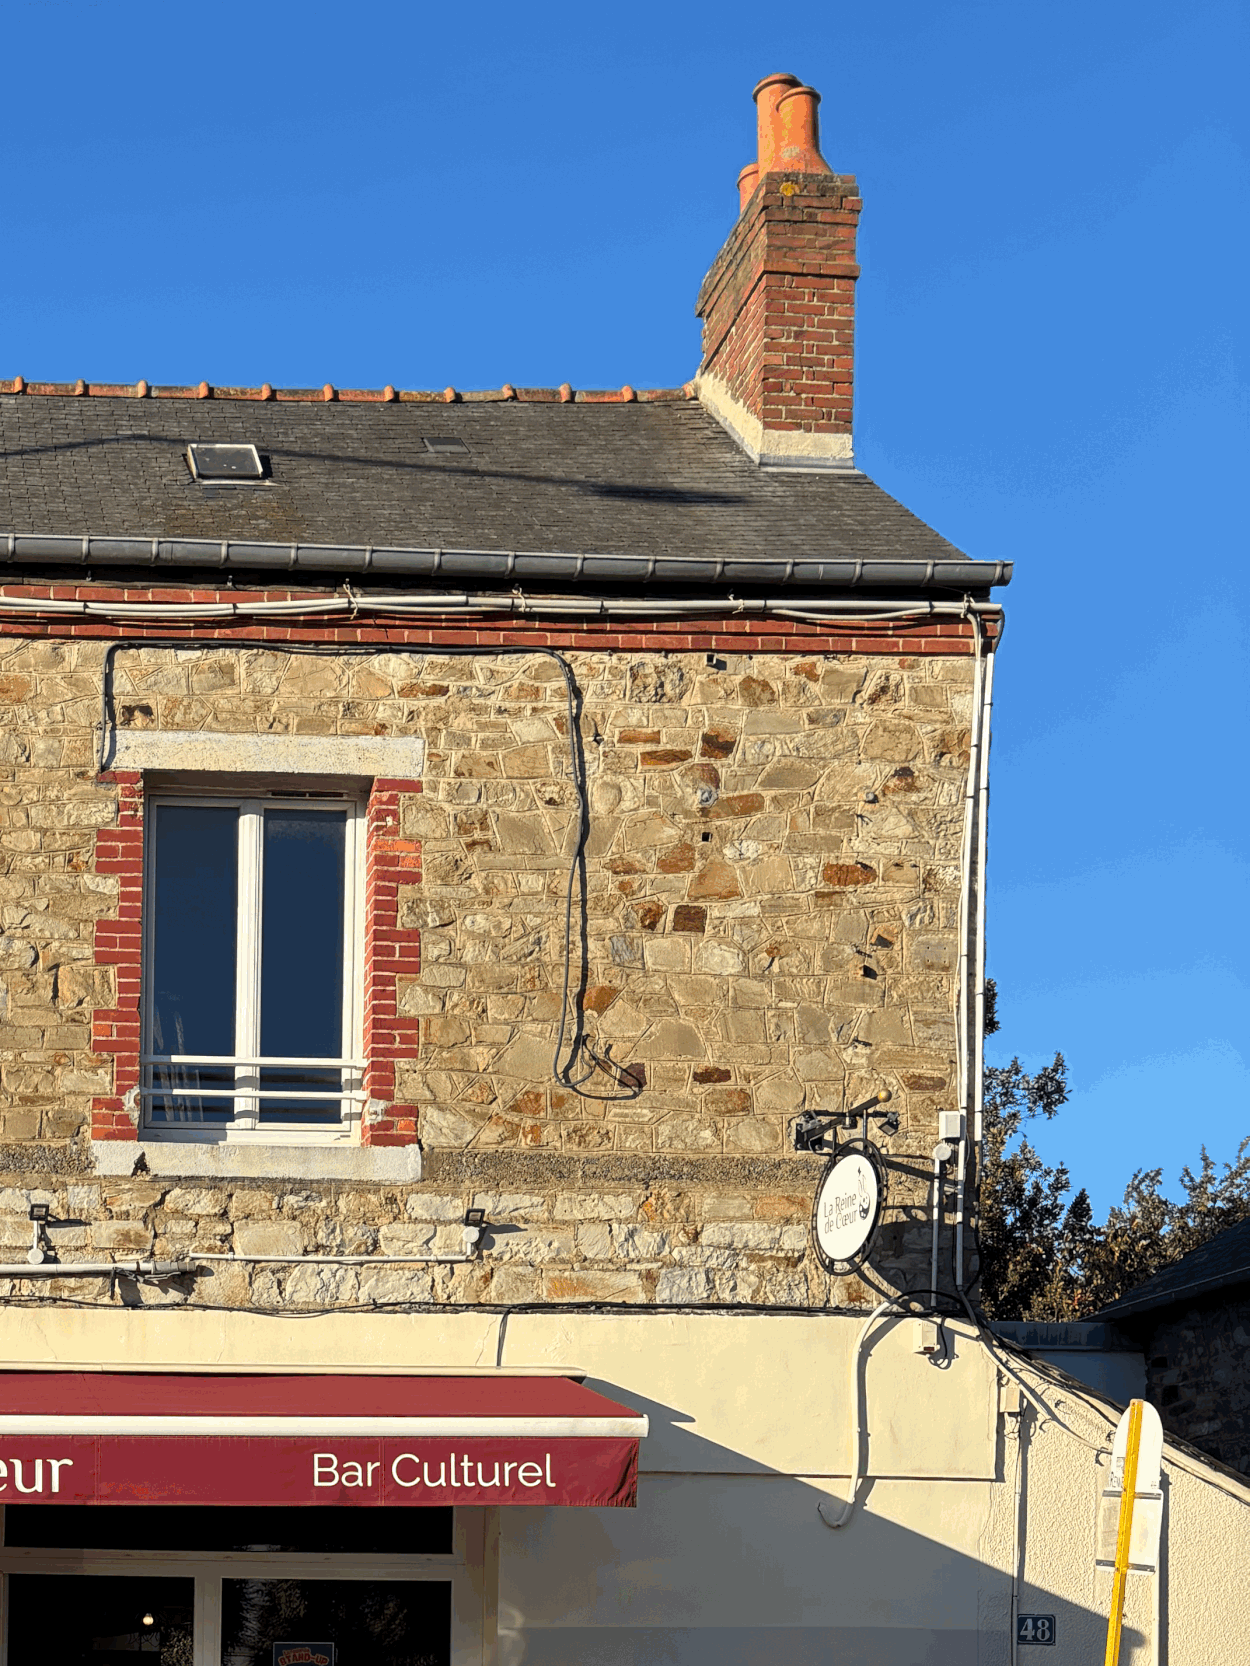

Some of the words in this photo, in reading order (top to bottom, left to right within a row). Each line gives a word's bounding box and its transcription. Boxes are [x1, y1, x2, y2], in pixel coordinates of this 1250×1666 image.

[824, 1202, 833, 1218] La
[835, 1192, 857, 1213] Reine
[825, 1217, 834, 1234] de
[313, 1453, 381, 1487] Bar
[391, 1452, 556, 1487] Culturel
[1019, 1618, 1051, 1641] 48
